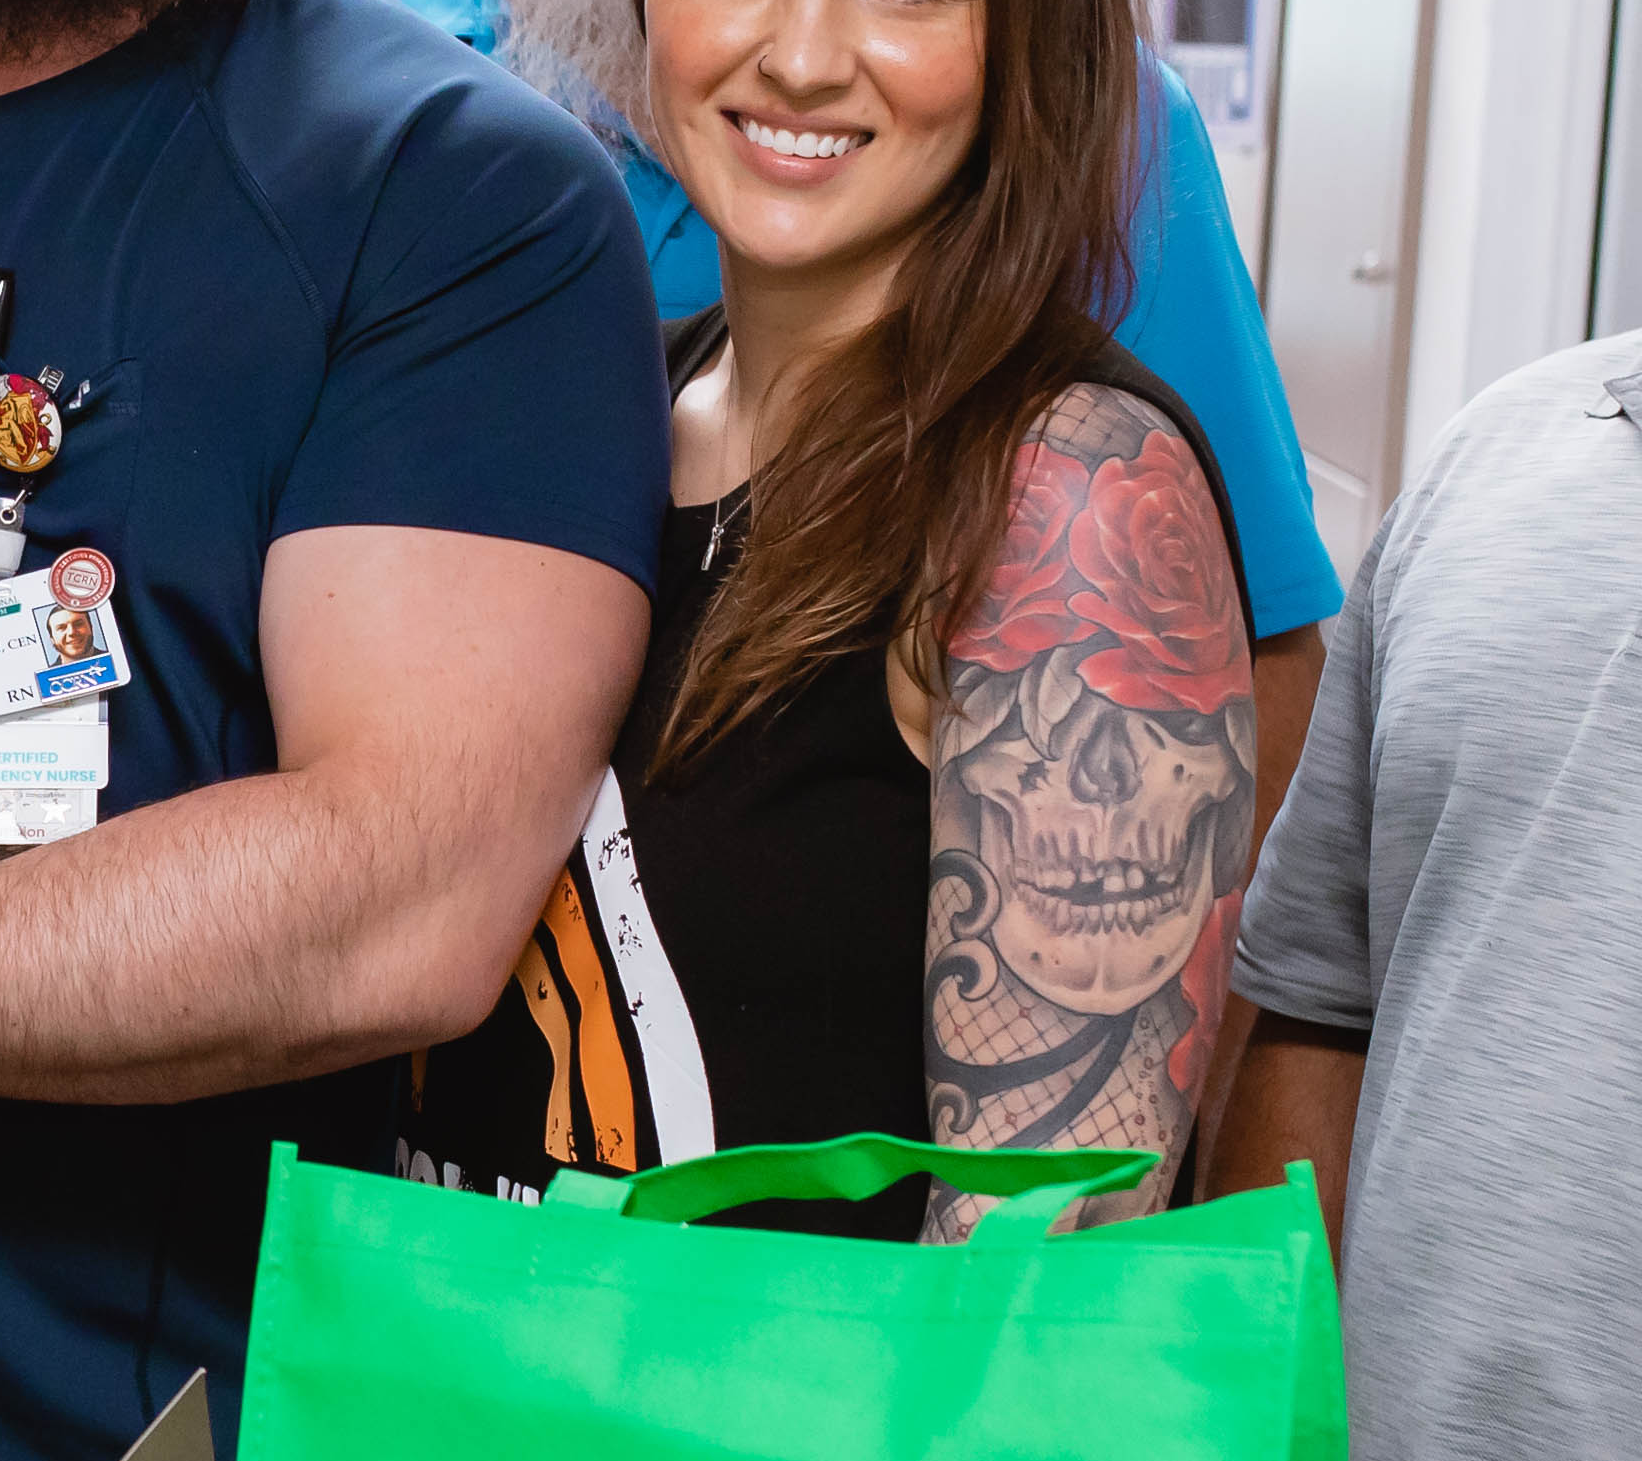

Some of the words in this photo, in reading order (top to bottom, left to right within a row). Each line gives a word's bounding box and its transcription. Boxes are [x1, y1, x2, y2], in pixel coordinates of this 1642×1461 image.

[67, 571, 98, 587] TCRN
[7, 634, 37, 650] CEN
[7, 685, 35, 703] RN
[47, 770, 97, 782] NURSE
